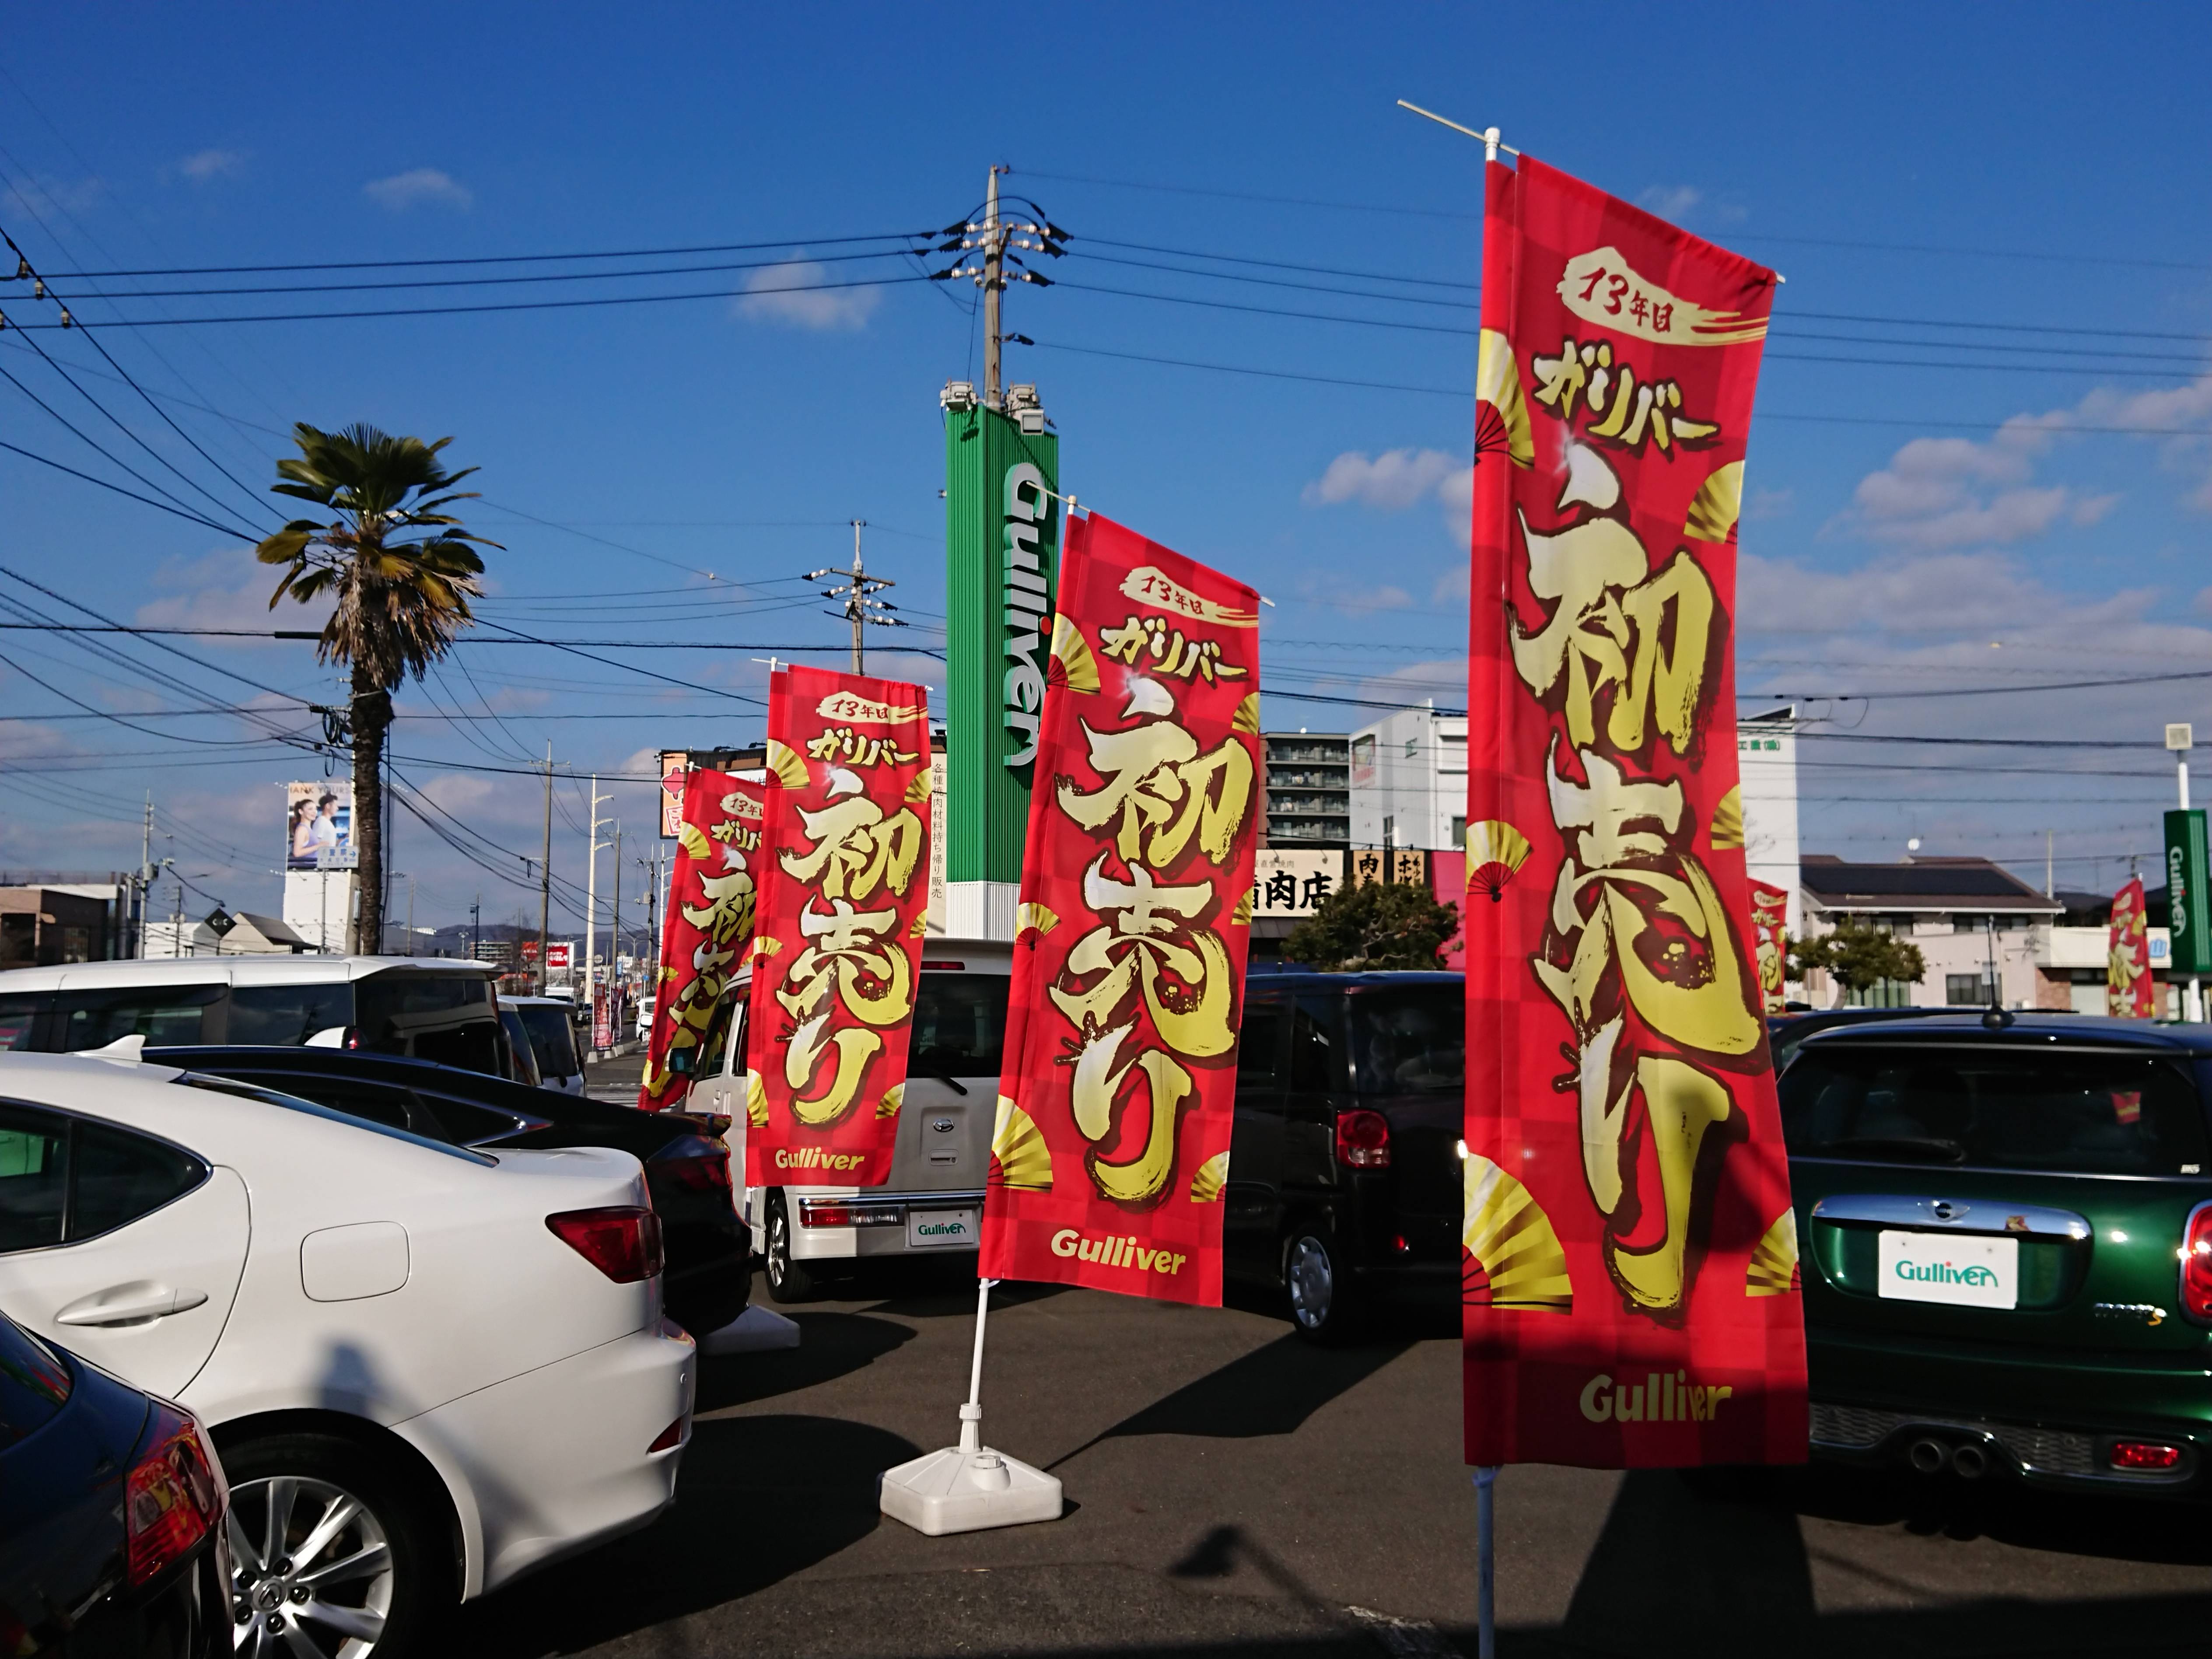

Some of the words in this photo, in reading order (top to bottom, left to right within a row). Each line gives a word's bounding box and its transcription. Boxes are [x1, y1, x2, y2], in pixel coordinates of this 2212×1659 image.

[1578, 267, 1674, 332] 13年目
[1532, 340, 1718, 450] ガリバー
[1004, 462, 1052, 766] Gulliver
[1141, 575, 1204, 615] 13年目
[1101, 617, 1247, 682] ガリバー
[831, 699, 889, 719] 13年目
[808, 728, 919, 766] ガリバー
[932, 763, 943, 899] 各種焼肉材料持ち帰り販売
[1509, 443, 1761, 1308] 初売り
[2170, 846, 2187, 938] Gulliver
[777, 768, 921, 1124] 初売り
[1049, 677, 1253, 1200] 初売り
[775, 1147, 864, 1170] Gulliver
[918, 1222, 966, 1236] Gulliver
[1051, 1228, 1186, 1275] Gulliver
[1895, 1260, 1998, 1288] Gulliver
[1579, 1368, 1732, 1423] Gulliver
